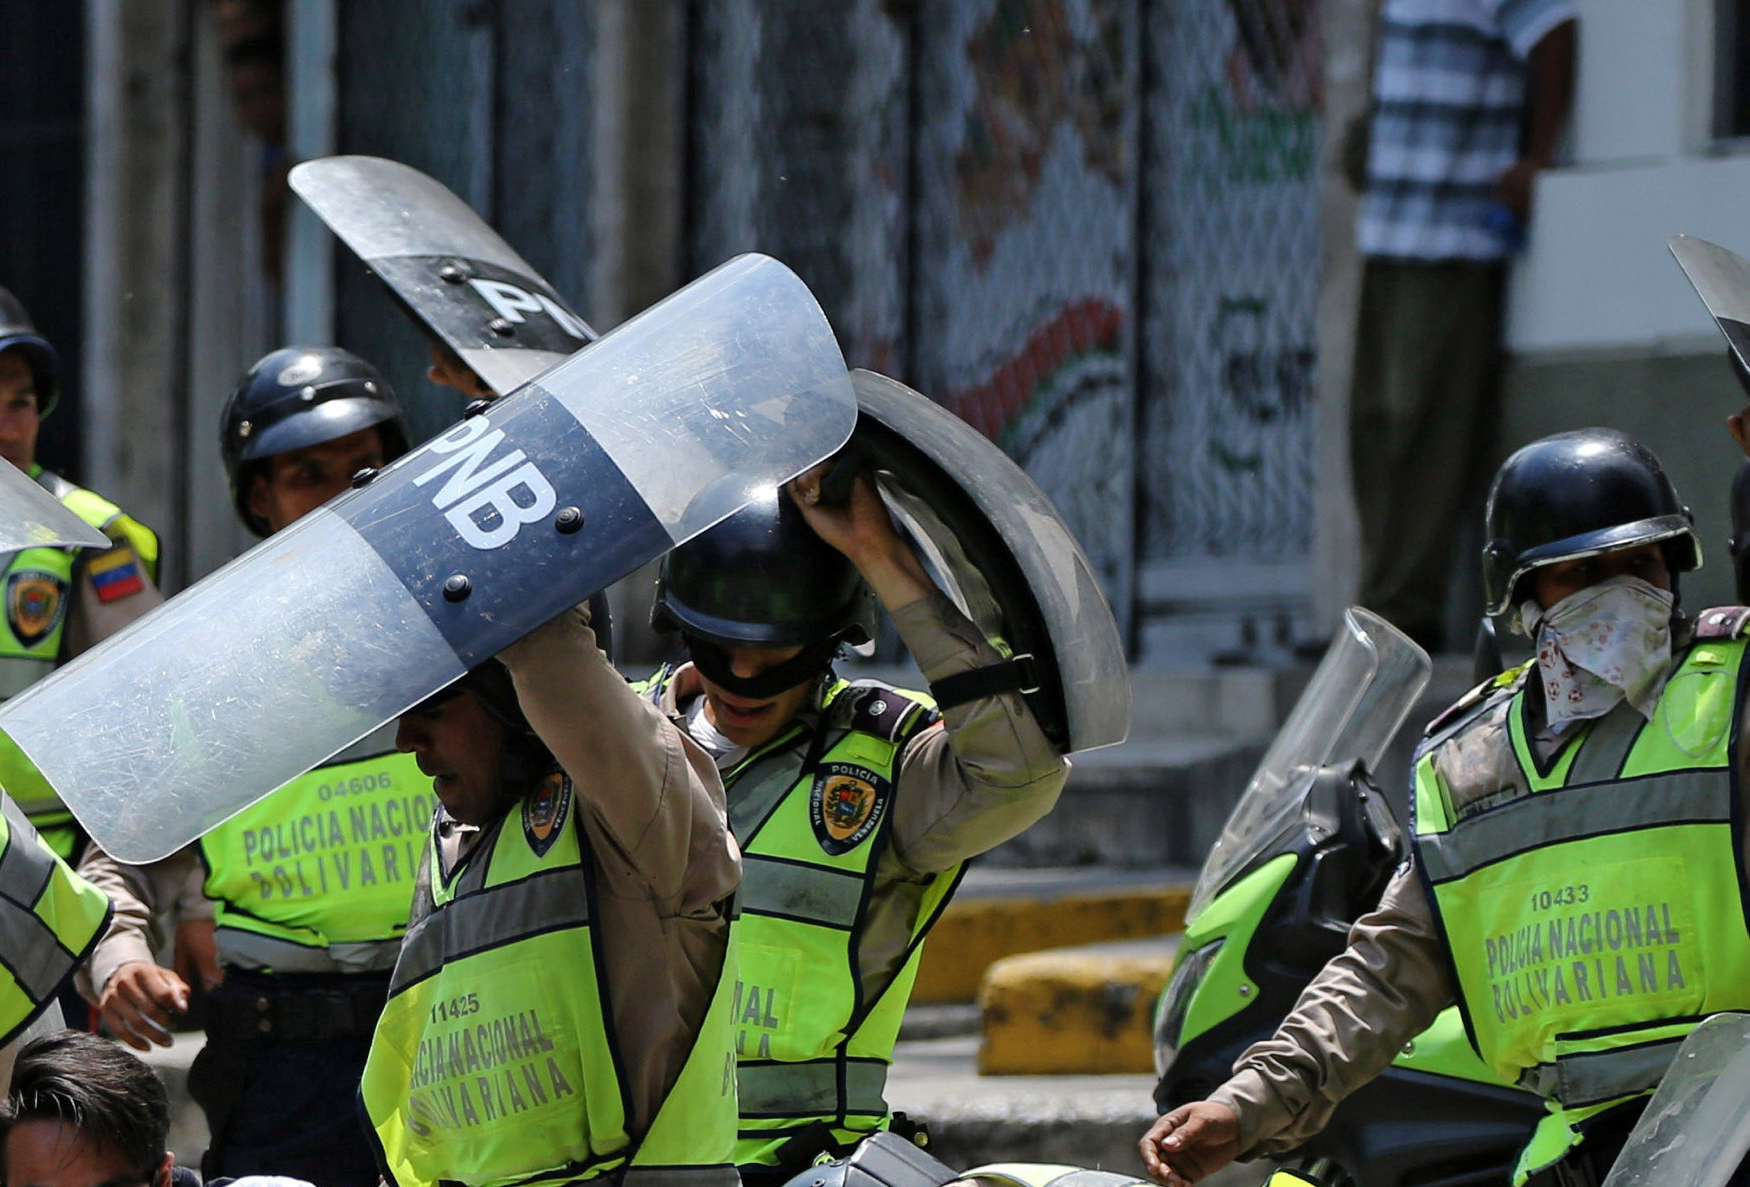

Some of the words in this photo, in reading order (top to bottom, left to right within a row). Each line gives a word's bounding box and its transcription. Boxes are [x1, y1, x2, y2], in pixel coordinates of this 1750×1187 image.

[412, 414, 557, 550] PNB
[318, 771, 392, 802] 04606
[831, 764, 879, 785] POLICIA
[812, 780, 825, 827] NACIONAL
[852, 798, 885, 841] VENEZUELA
[243, 811, 325, 866] POLICIA
[1530, 884, 1590, 912] 10433
[1484, 922, 1545, 979] POLICIA
[1550, 902, 1680, 960] NACIONAL
[431, 993, 481, 1024] 11425
[1492, 949, 1686, 1024] BOLIVARIANA
[448, 1008, 555, 1079] NACIONAL
